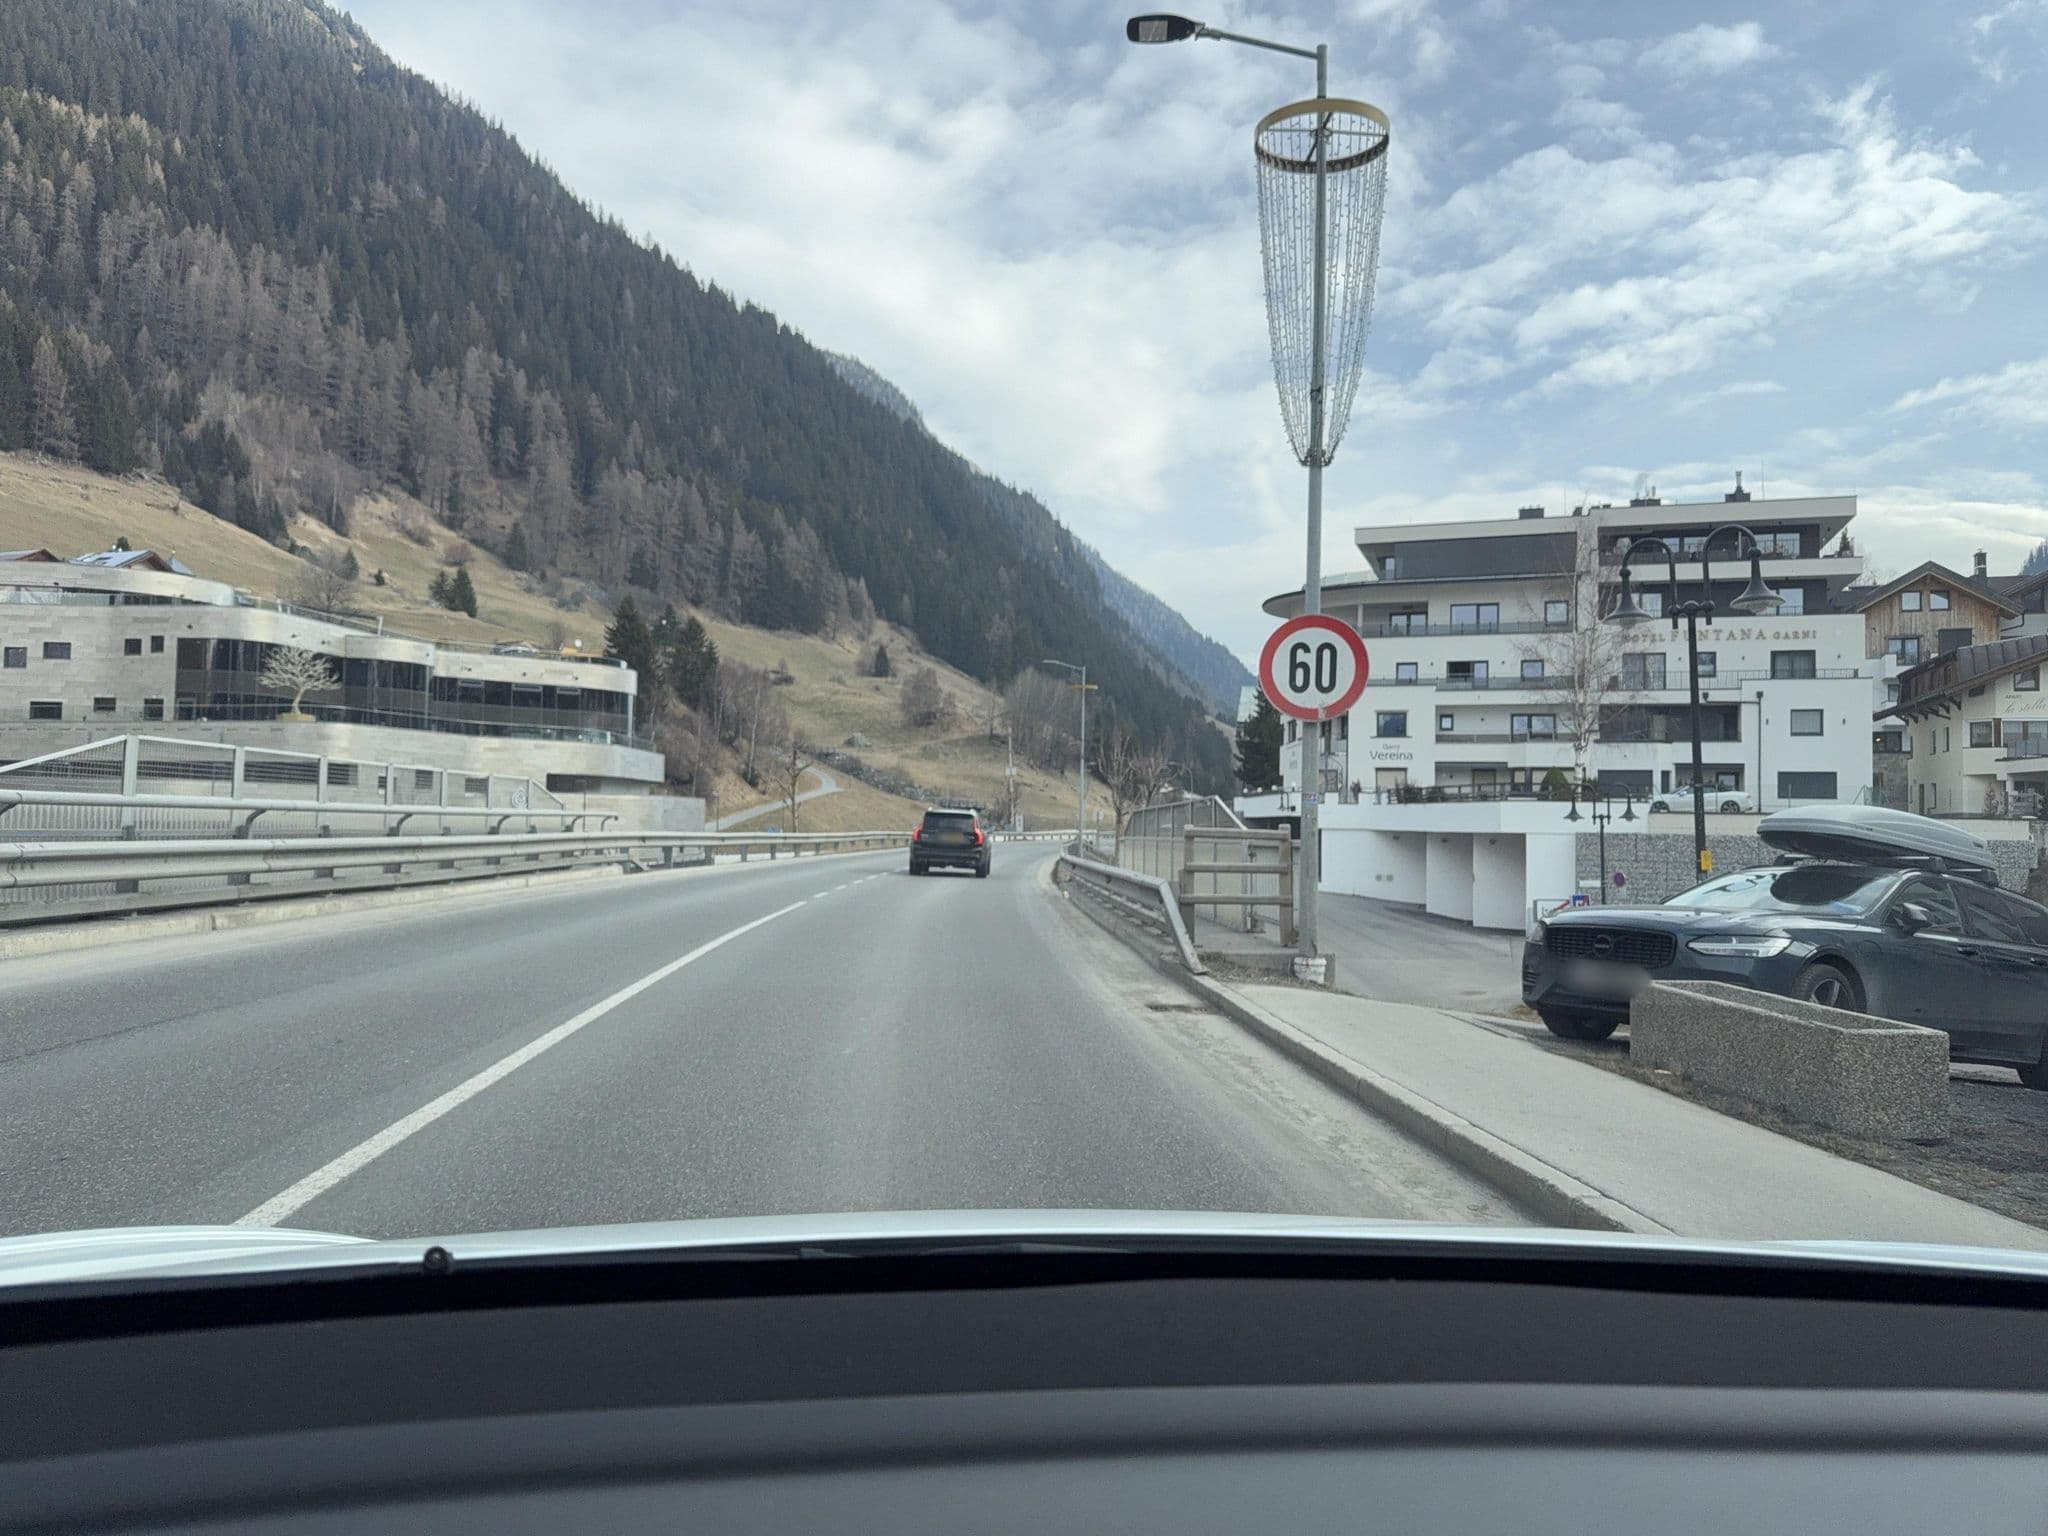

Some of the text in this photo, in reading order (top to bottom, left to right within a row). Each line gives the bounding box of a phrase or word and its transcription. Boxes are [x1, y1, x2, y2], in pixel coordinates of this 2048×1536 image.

[1773, 630, 1817, 640] GARNI
[1289, 642, 1337, 693] 60
[1369, 750, 1413, 760] Vereina
